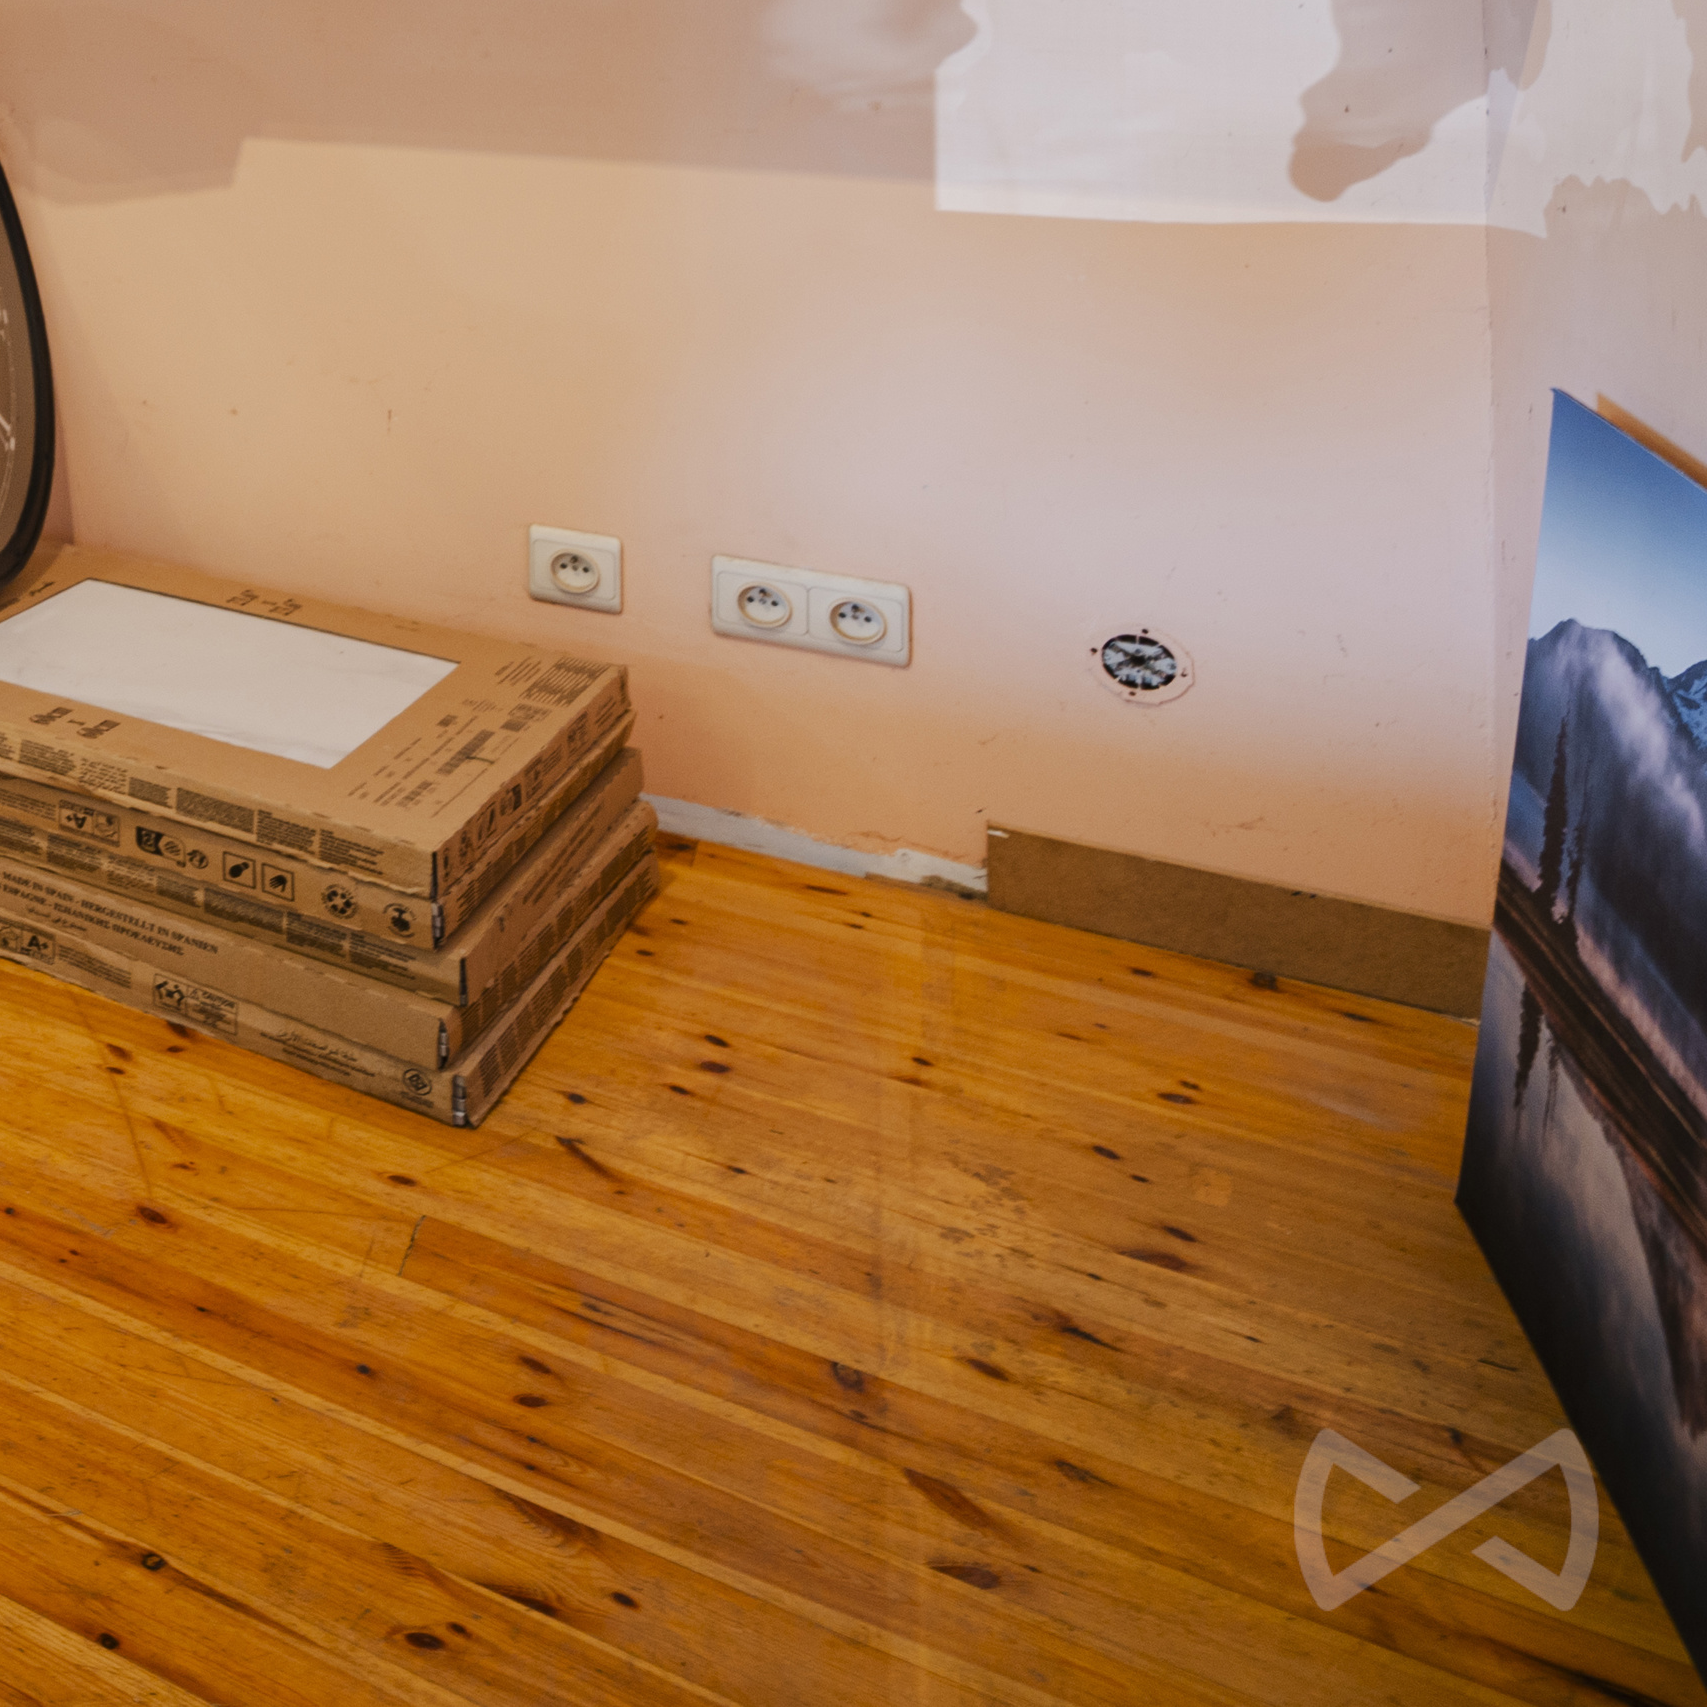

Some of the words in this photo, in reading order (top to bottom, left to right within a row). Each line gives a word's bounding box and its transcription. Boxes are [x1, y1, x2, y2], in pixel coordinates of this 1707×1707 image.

[2, 870, 31, 888] MADE
[44, 885, 74, 904] SPAIN
[80, 897, 155, 933] HERGESTELLT
